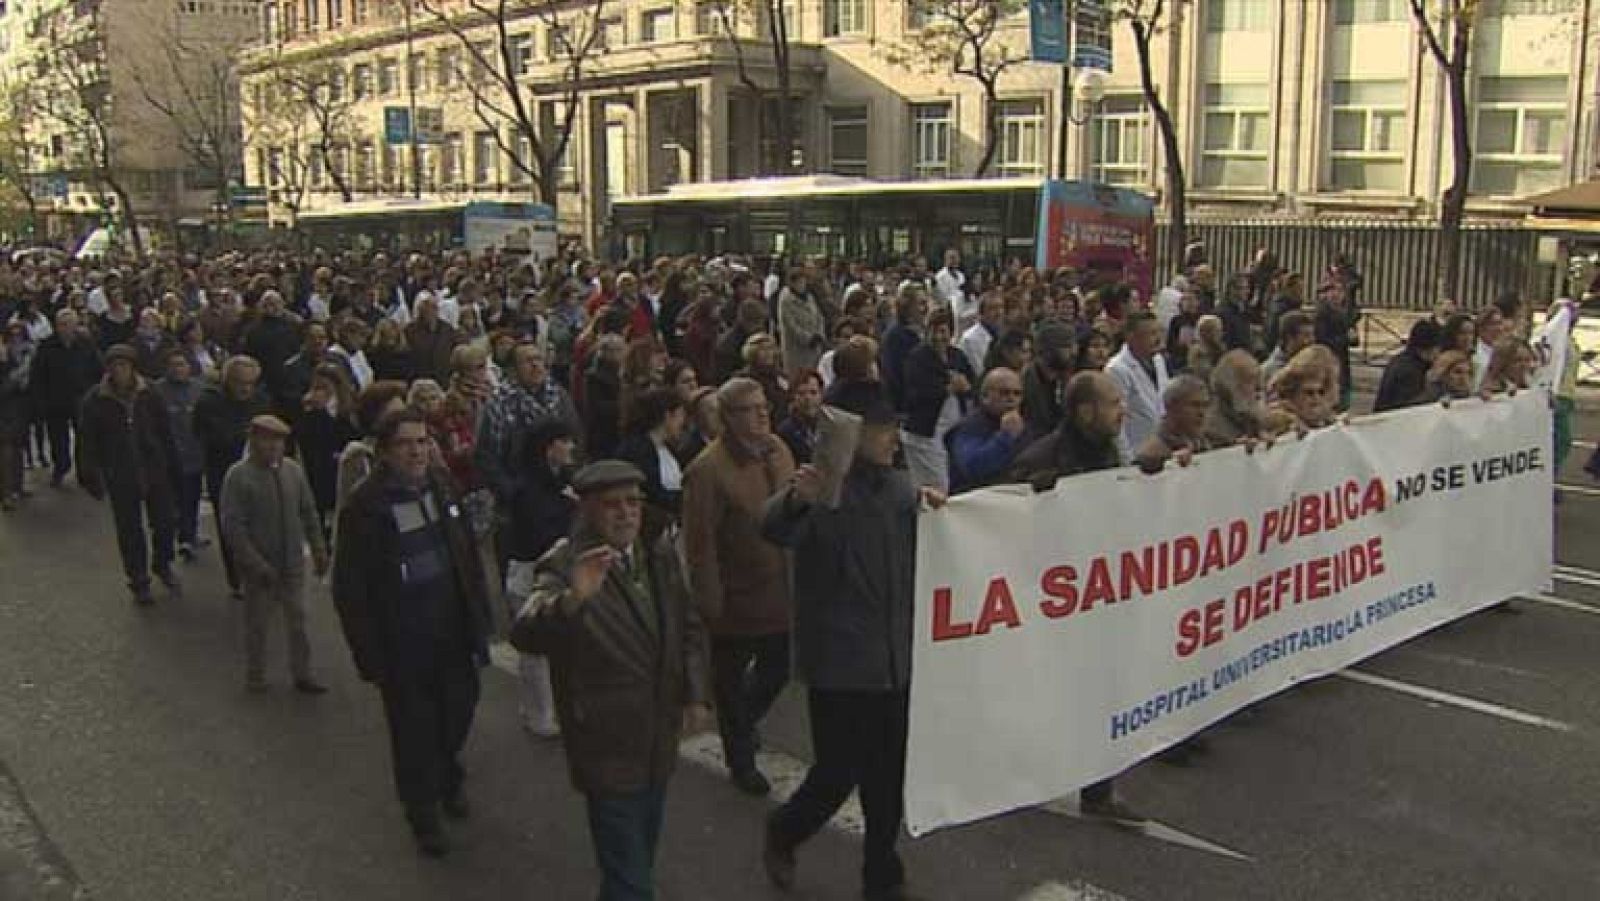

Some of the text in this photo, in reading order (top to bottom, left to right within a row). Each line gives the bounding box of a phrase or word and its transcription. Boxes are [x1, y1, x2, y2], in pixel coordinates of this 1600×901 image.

[932, 587, 1021, 642] LA
[1039, 518, 1248, 618] SANIDAD
[1259, 477, 1386, 554] PÚBLICA
[1395, 473, 1426, 504] NO
[1431, 464, 1465, 491] SE
[1175, 535, 1386, 658] SE DEFIENDE
[1110, 581, 1437, 740] HOSPITAL UNIVERSITARIO LA PRINCESA
